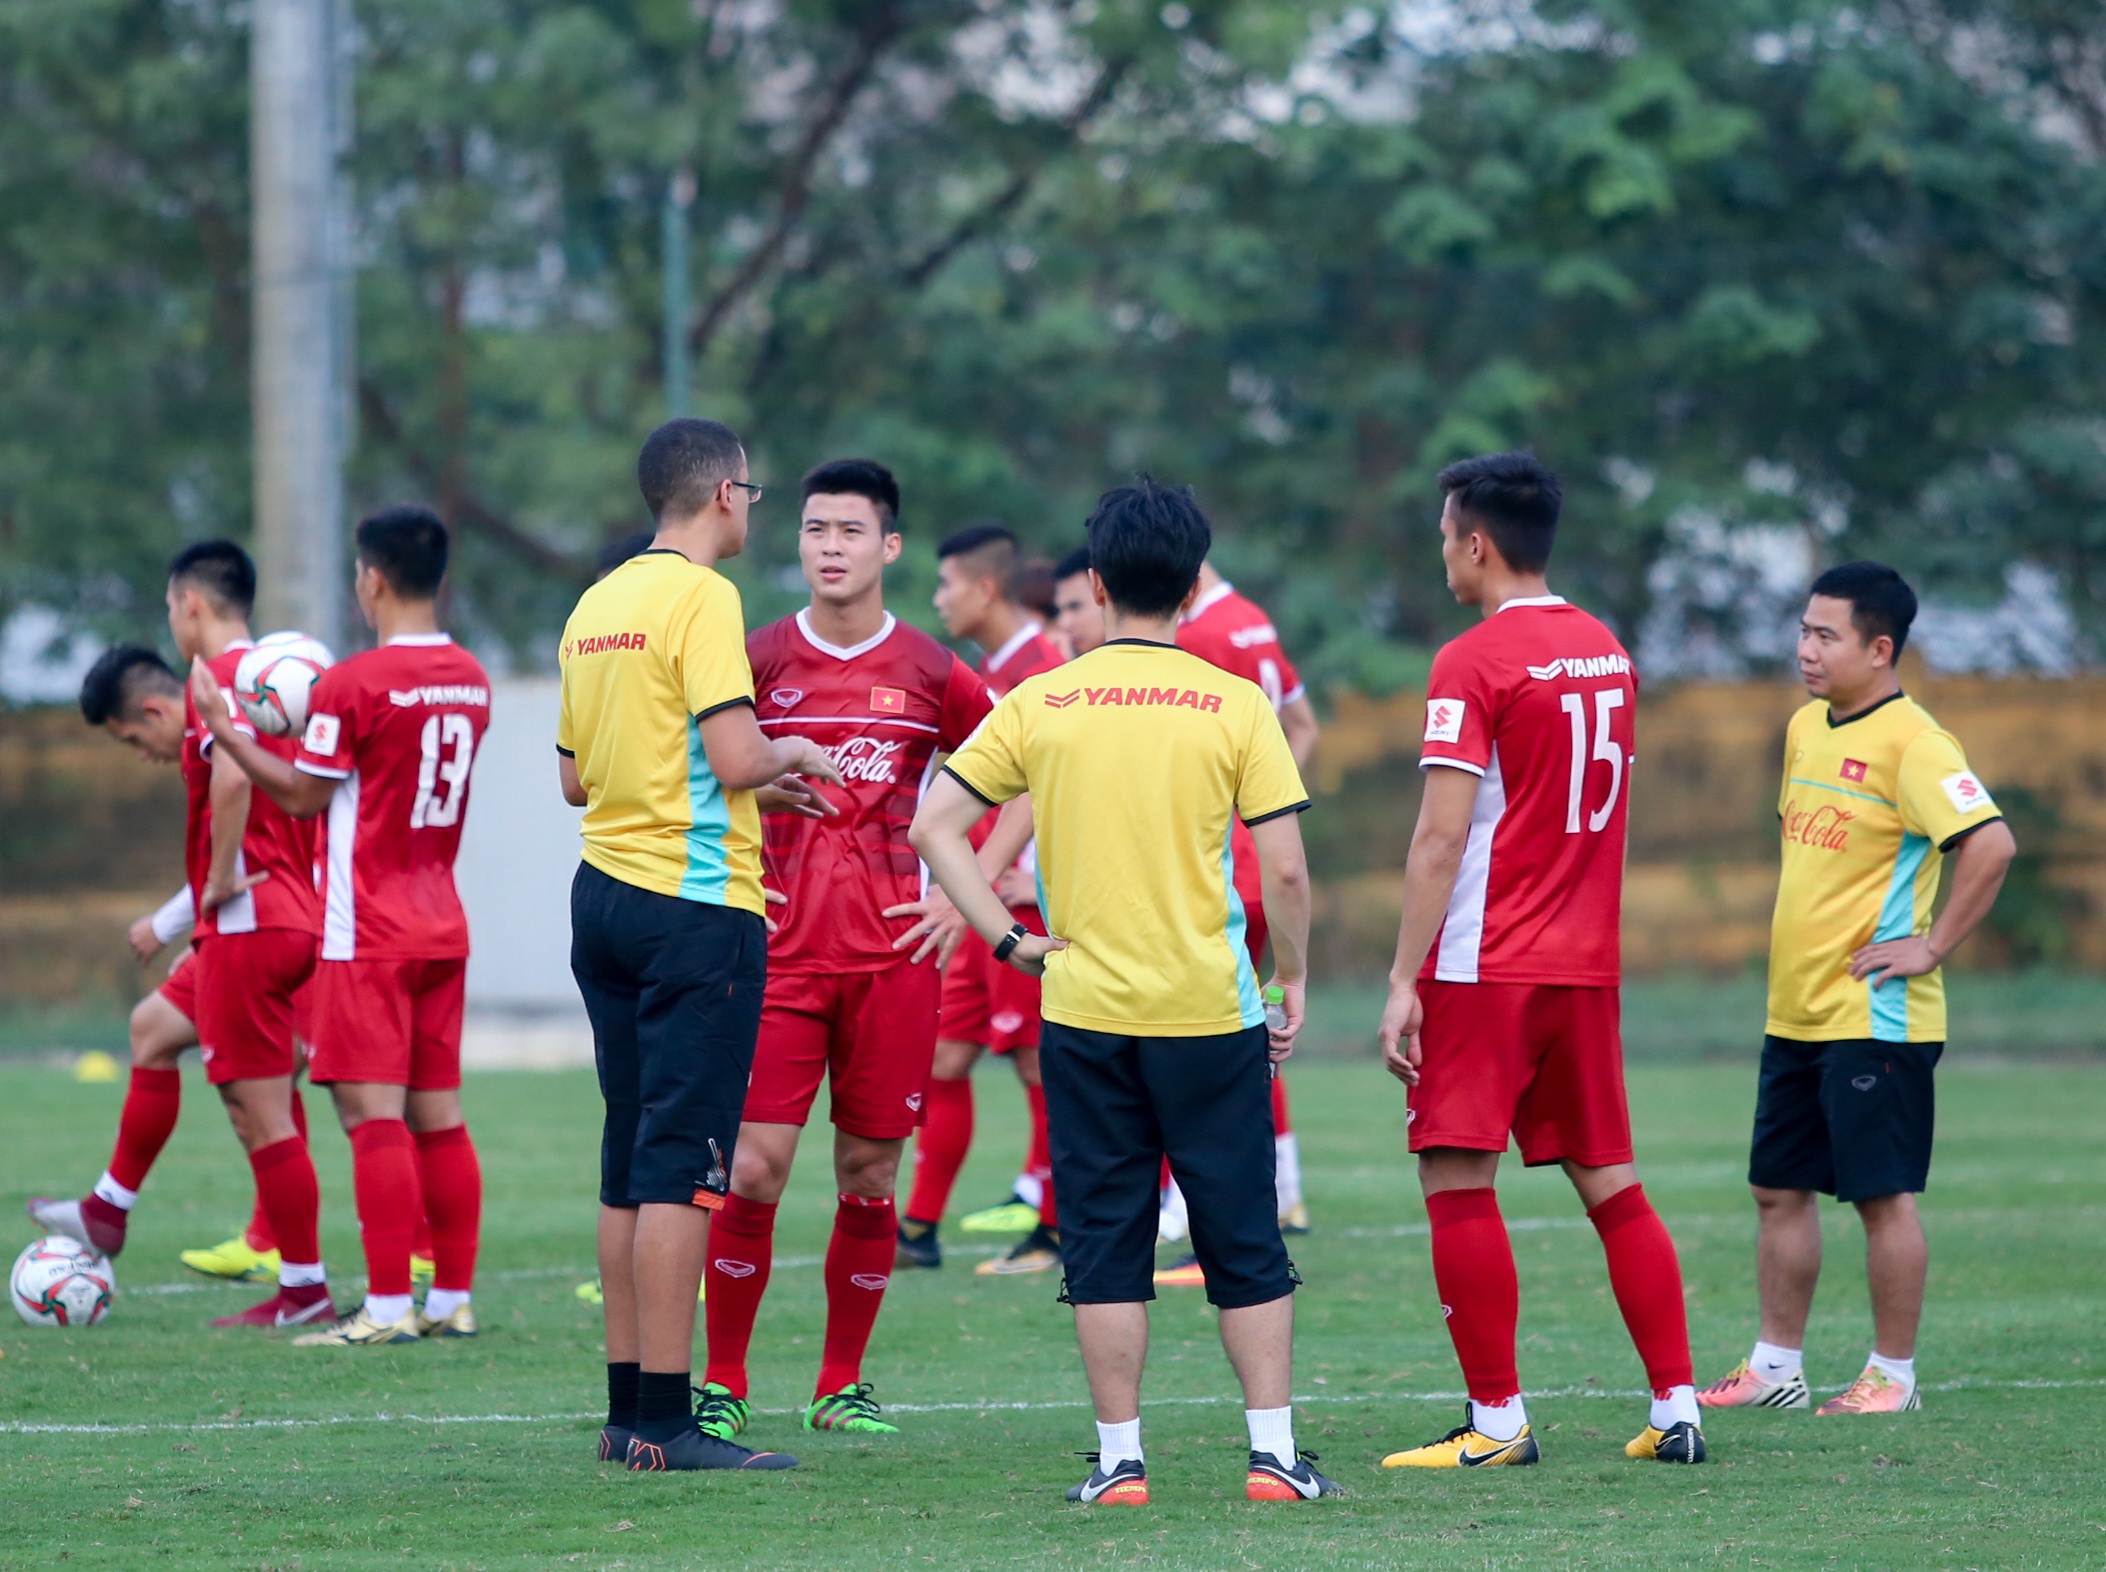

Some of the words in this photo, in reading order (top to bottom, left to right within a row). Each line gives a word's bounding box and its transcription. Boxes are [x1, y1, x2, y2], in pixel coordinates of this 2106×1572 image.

[577, 633, 646, 656] YANMAR
[1084, 687, 1223, 713] YANMAR
[410, 713, 474, 829] 13
[1560, 688, 1624, 834] 15
